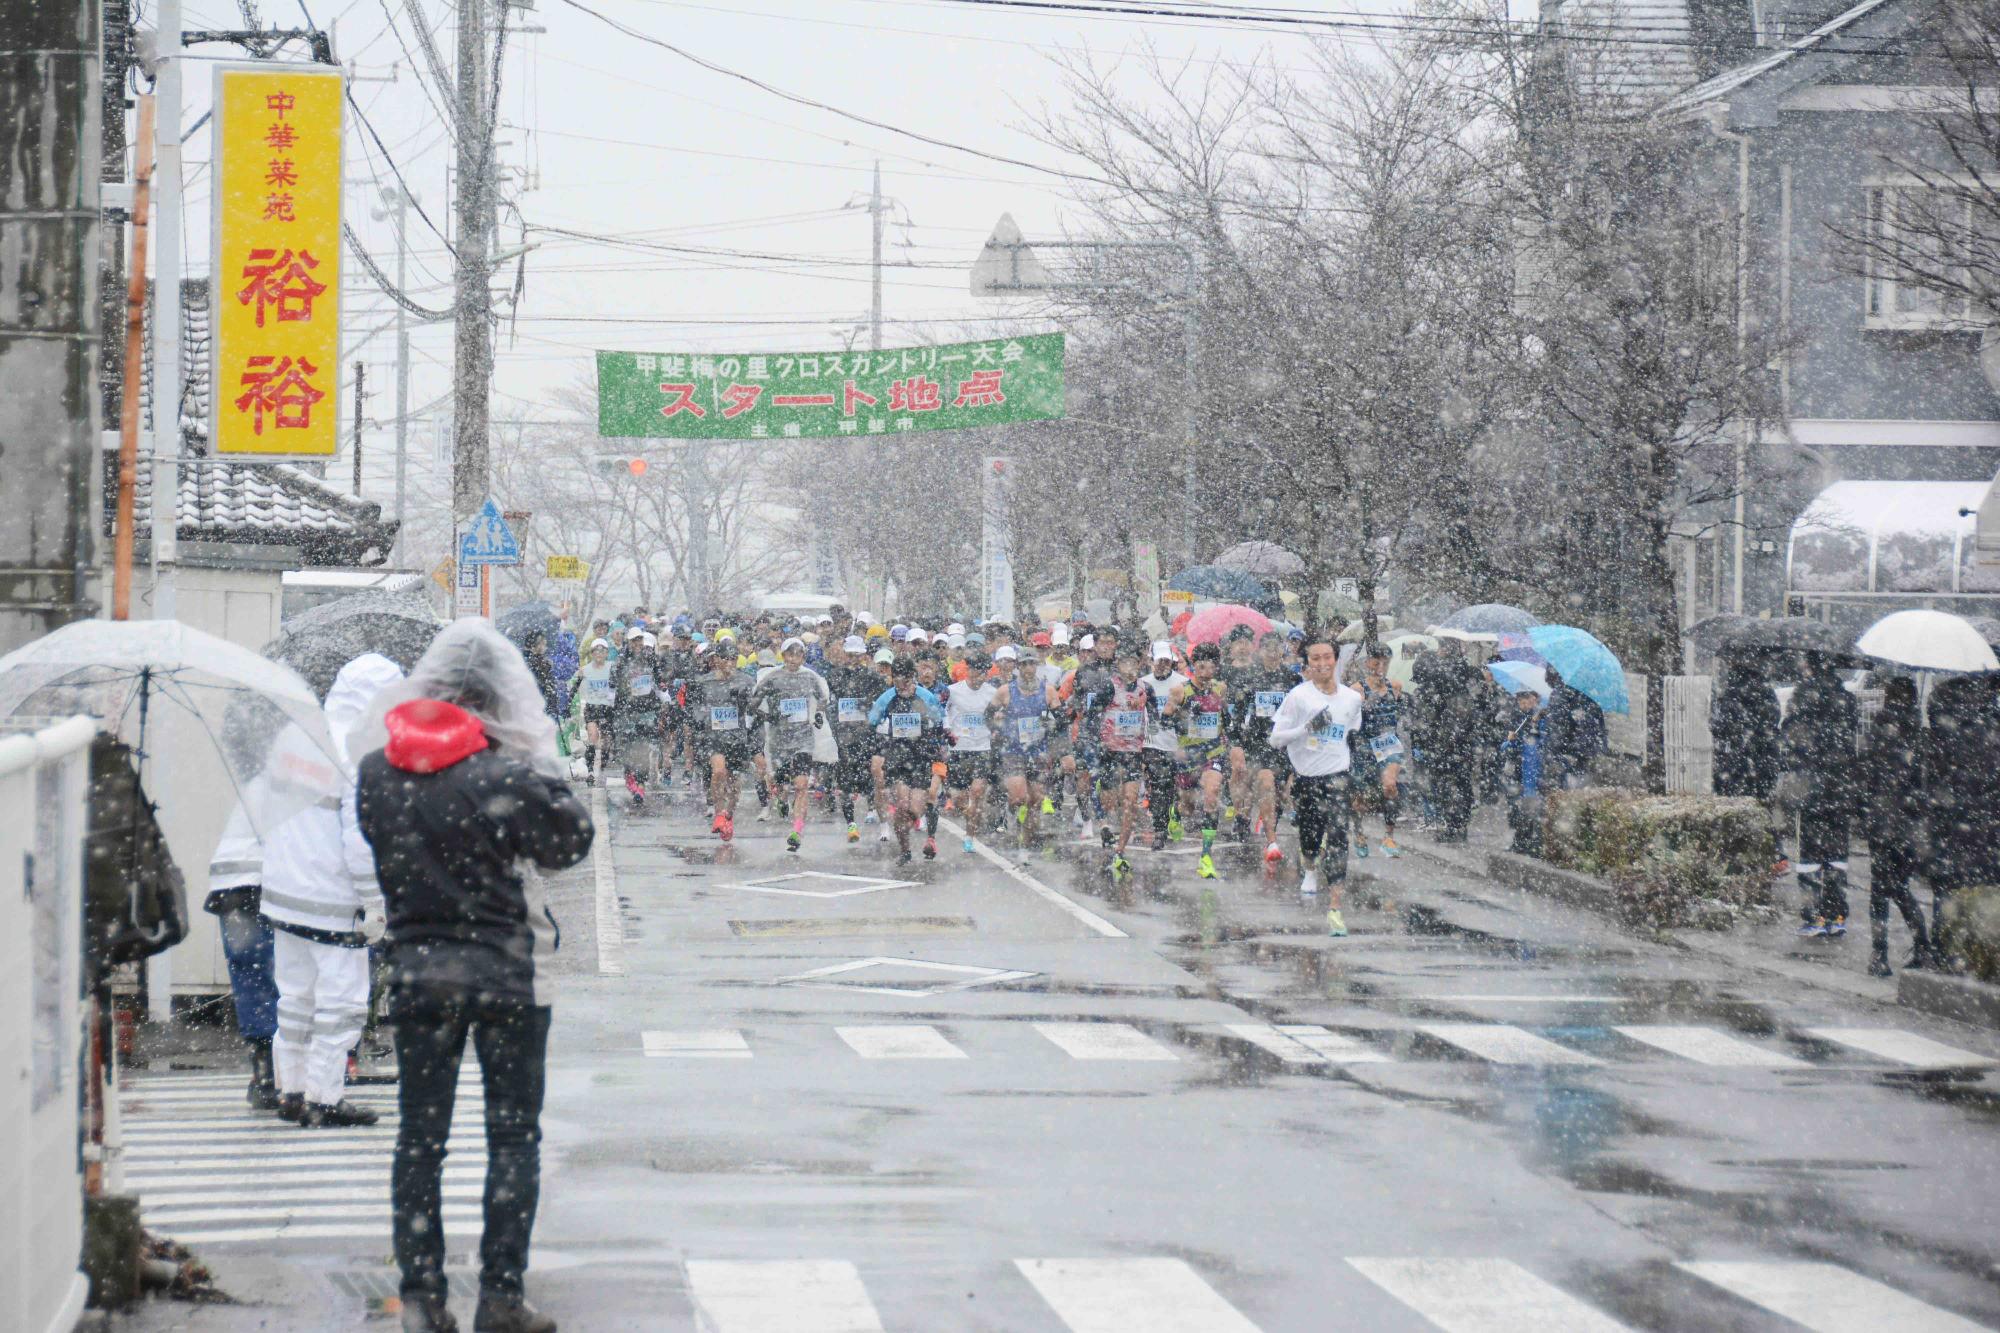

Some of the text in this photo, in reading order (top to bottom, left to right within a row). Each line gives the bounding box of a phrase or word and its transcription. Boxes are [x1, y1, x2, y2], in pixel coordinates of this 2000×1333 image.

[263, 90, 299, 222] 中華菜苑
[235, 248, 327, 435] 裕裕
[659, 369, 1007, 419] スタート地点
